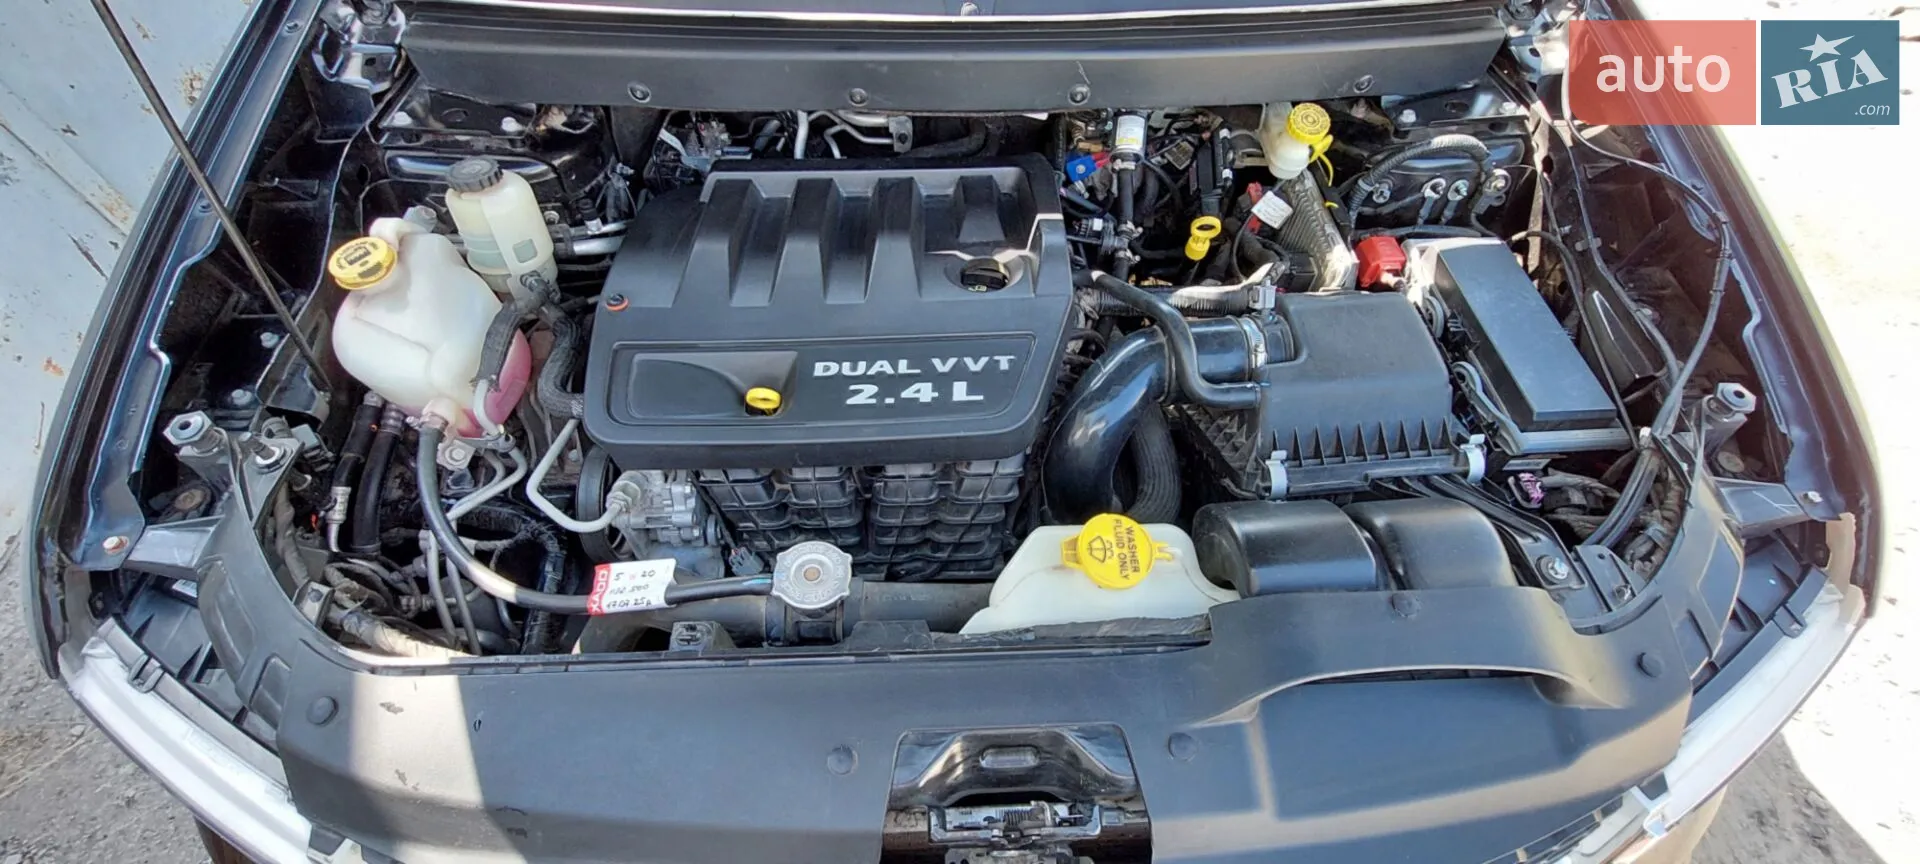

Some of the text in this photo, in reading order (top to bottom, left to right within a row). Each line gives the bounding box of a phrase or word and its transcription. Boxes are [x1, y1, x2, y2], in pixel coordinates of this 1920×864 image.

[813, 355, 1017, 377] DUAL VVT
[845, 381, 984, 405] 2.4 L
[1114, 519, 1130, 580] FLUID ONLY
[1125, 526, 1140, 573] WASHER
[590, 570, 608, 613] XADO
[613, 572, 625, 581] 5
[640, 569, 656, 578] 20
